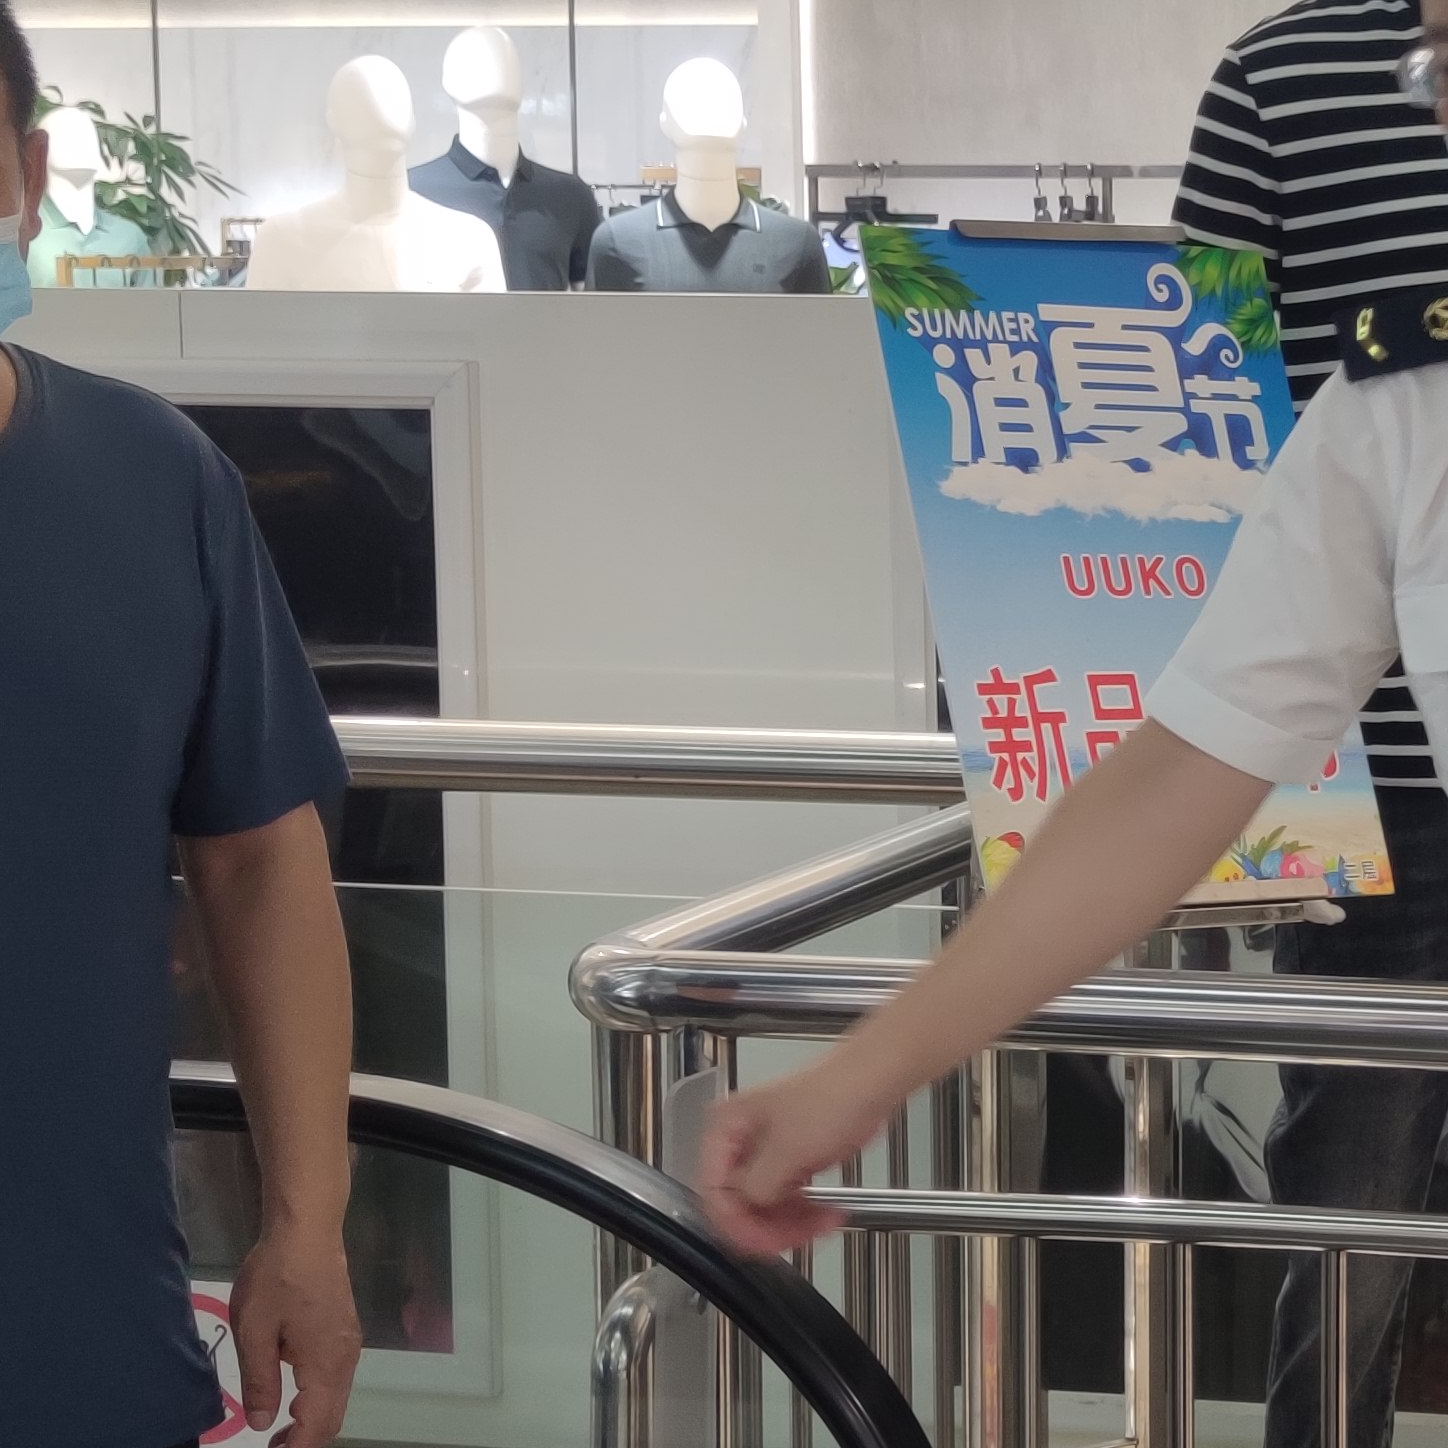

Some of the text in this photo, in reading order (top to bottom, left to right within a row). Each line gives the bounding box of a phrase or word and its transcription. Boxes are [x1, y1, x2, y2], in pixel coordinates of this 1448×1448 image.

[904, 307, 1040, 345] SUMMER
[932, 262, 1270, 466] 消夏节
[1061, 554, 1207, 599] UUKO
